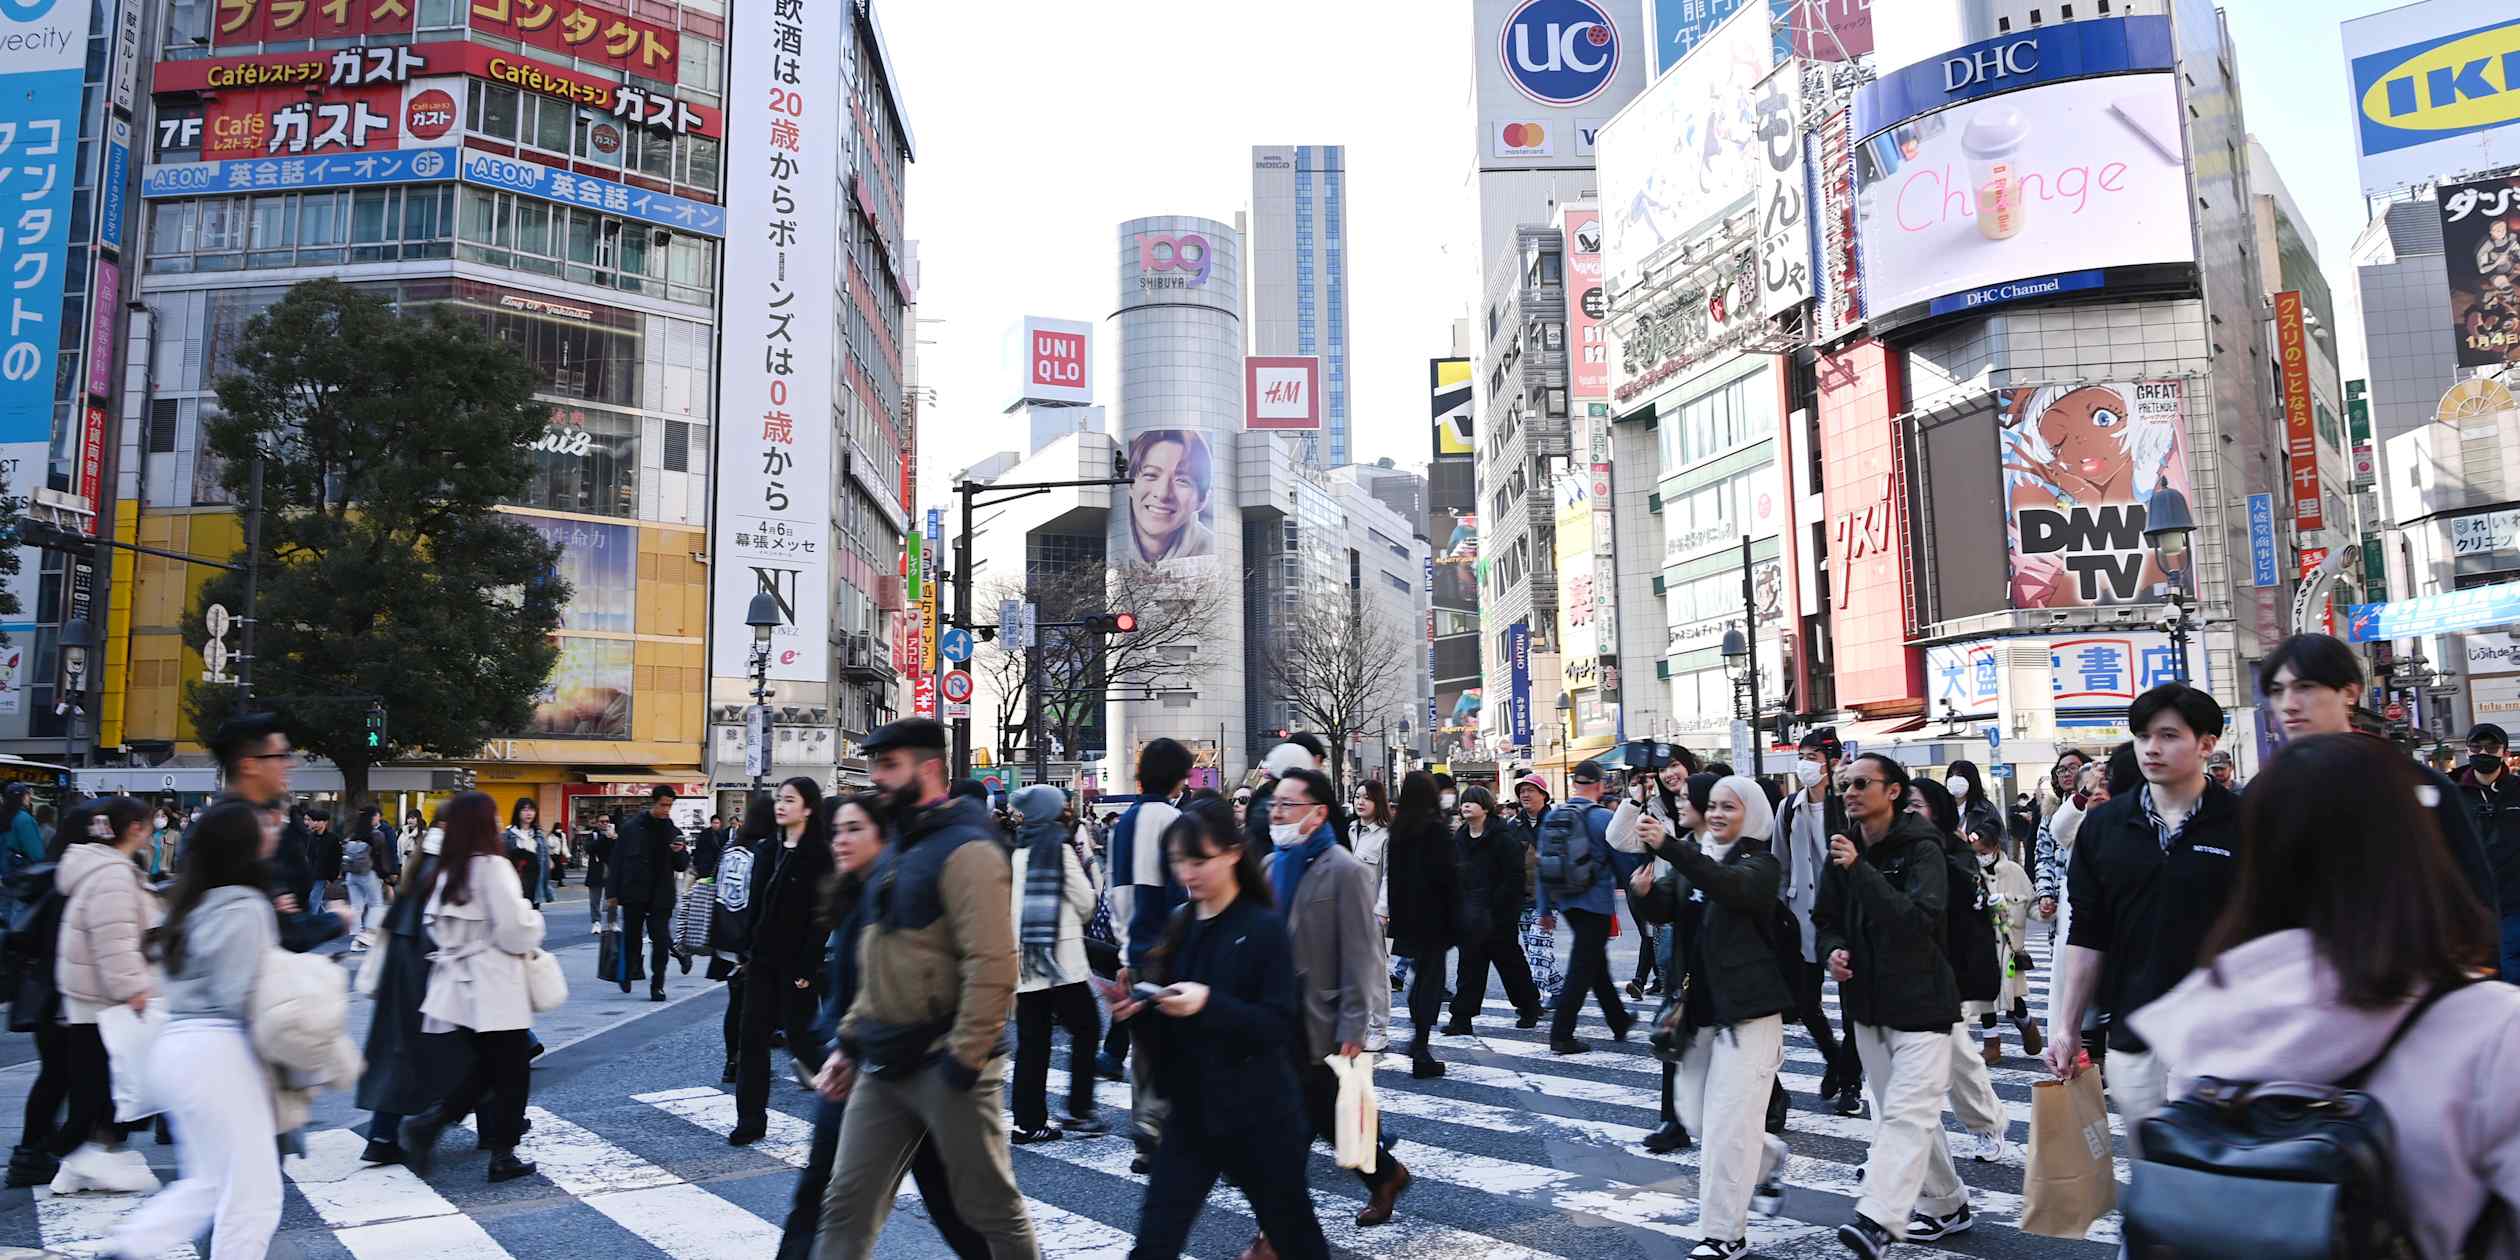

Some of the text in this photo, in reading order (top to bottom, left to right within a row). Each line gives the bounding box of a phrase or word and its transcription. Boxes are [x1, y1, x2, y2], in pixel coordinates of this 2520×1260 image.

[208, 45, 425, 87] Café レストラン ガスト
[1942, 40, 2039, 93] DHC
[489, 58, 703, 134] Café レストラン ガスト
[159, 118, 201, 149] 7F
[214, 113, 265, 137] Café
[268, 103, 389, 153] ガスト
[412, 112, 451, 127] ガスト
[213, 135, 265, 152] レストラン
[152, 153, 442, 190] AEON 英会話イーオン 6F
[1757, 78, 1806, 296] もんじゃ
[473, 159, 721, 228] AEON 英会話イーオン
[3, 119, 61, 381] コンタクトの
[1136, 234, 1212, 289] 109
[1140, 277, 1185, 289] SHIBUYA
[1967, 279, 2061, 306] DHC Channel
[1038, 337, 1076, 358] UNI
[1038, 362, 1080, 382] QLO
[1264, 380, 1302, 404] H&M
[2136, 384, 2177, 399] GREAT
[2279, 298, 2321, 519] クスリのことなら 三千里
[736, 533, 815, 553] 幕張メッセ
[758, 521, 793, 537] 4月6日
[2066, 553, 2144, 600] TV
[1515, 633, 1525, 670] MIZUHO
[1941, 643, 2186, 700] 大盛書店
